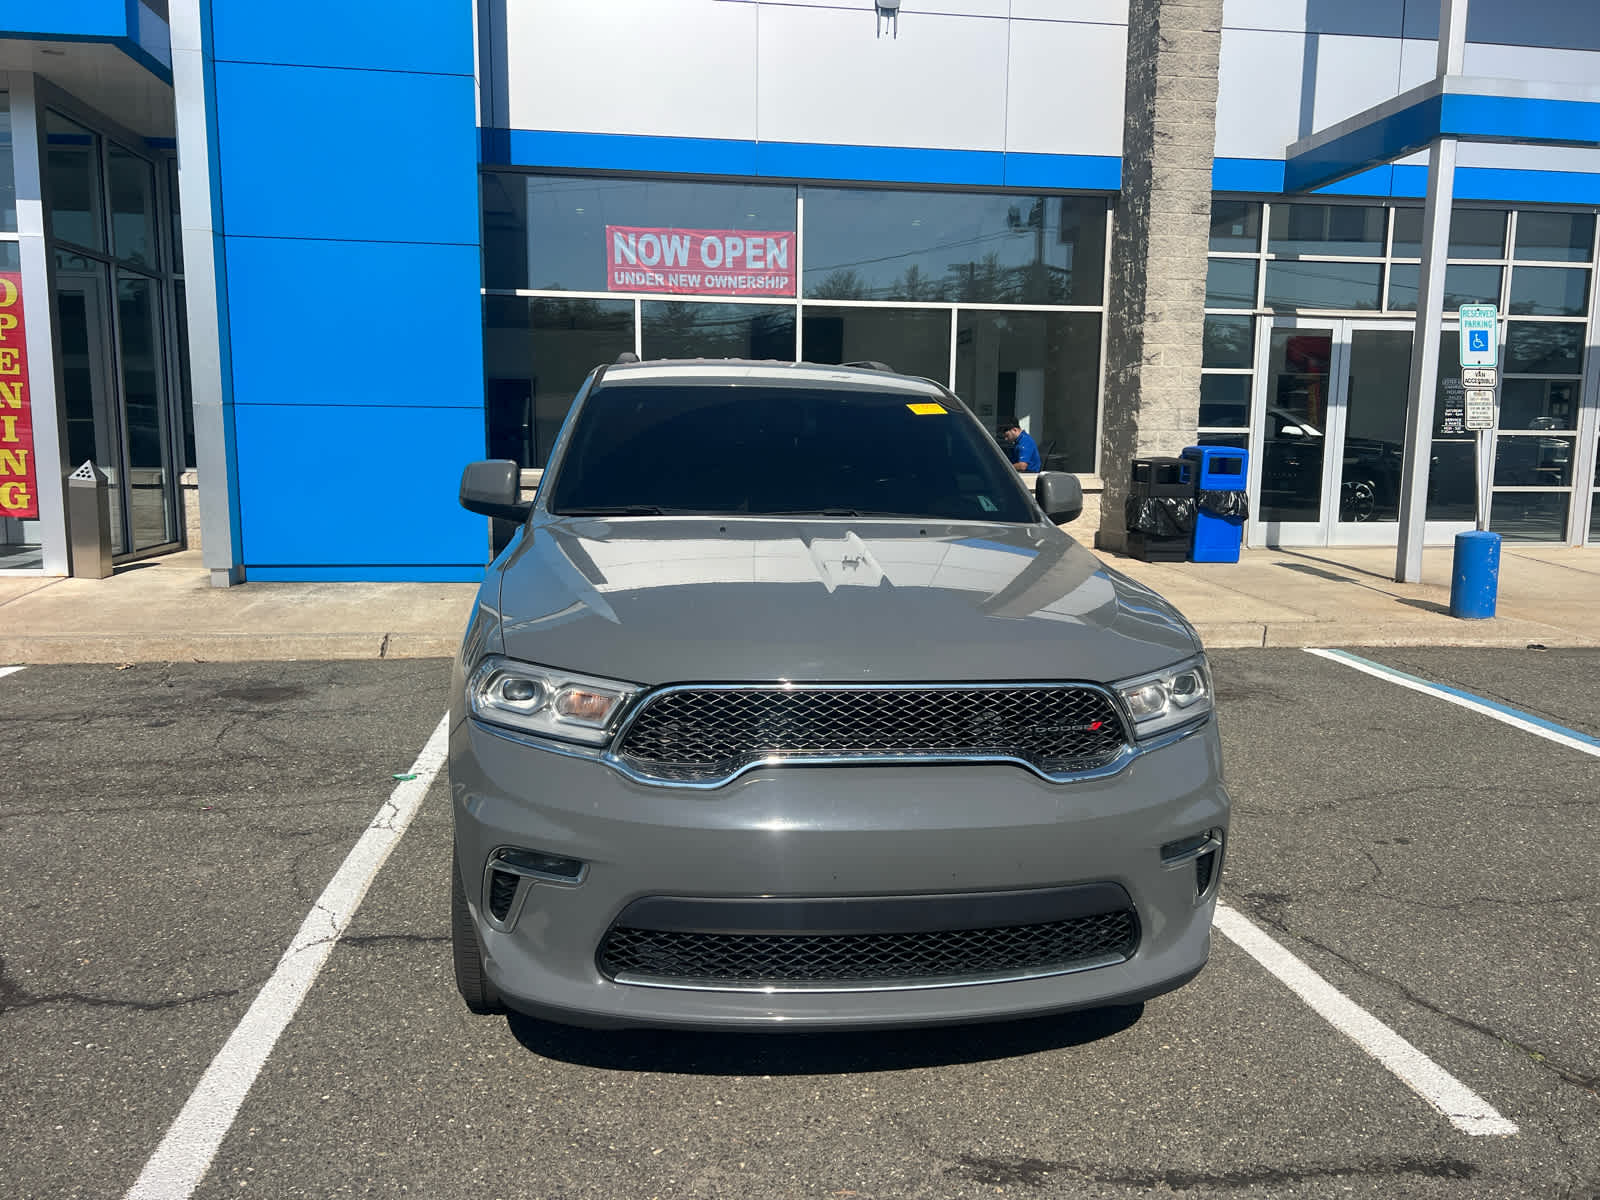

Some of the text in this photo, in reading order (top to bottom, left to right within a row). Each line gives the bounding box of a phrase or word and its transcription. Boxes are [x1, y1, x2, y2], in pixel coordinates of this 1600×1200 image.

[613, 231, 788, 269] NOW OPEN
[614, 271, 789, 289] UNDER NEW OWNERSHIP
[1463, 309, 1494, 318] RESERVED
[1464, 320, 1493, 328] PARKING
